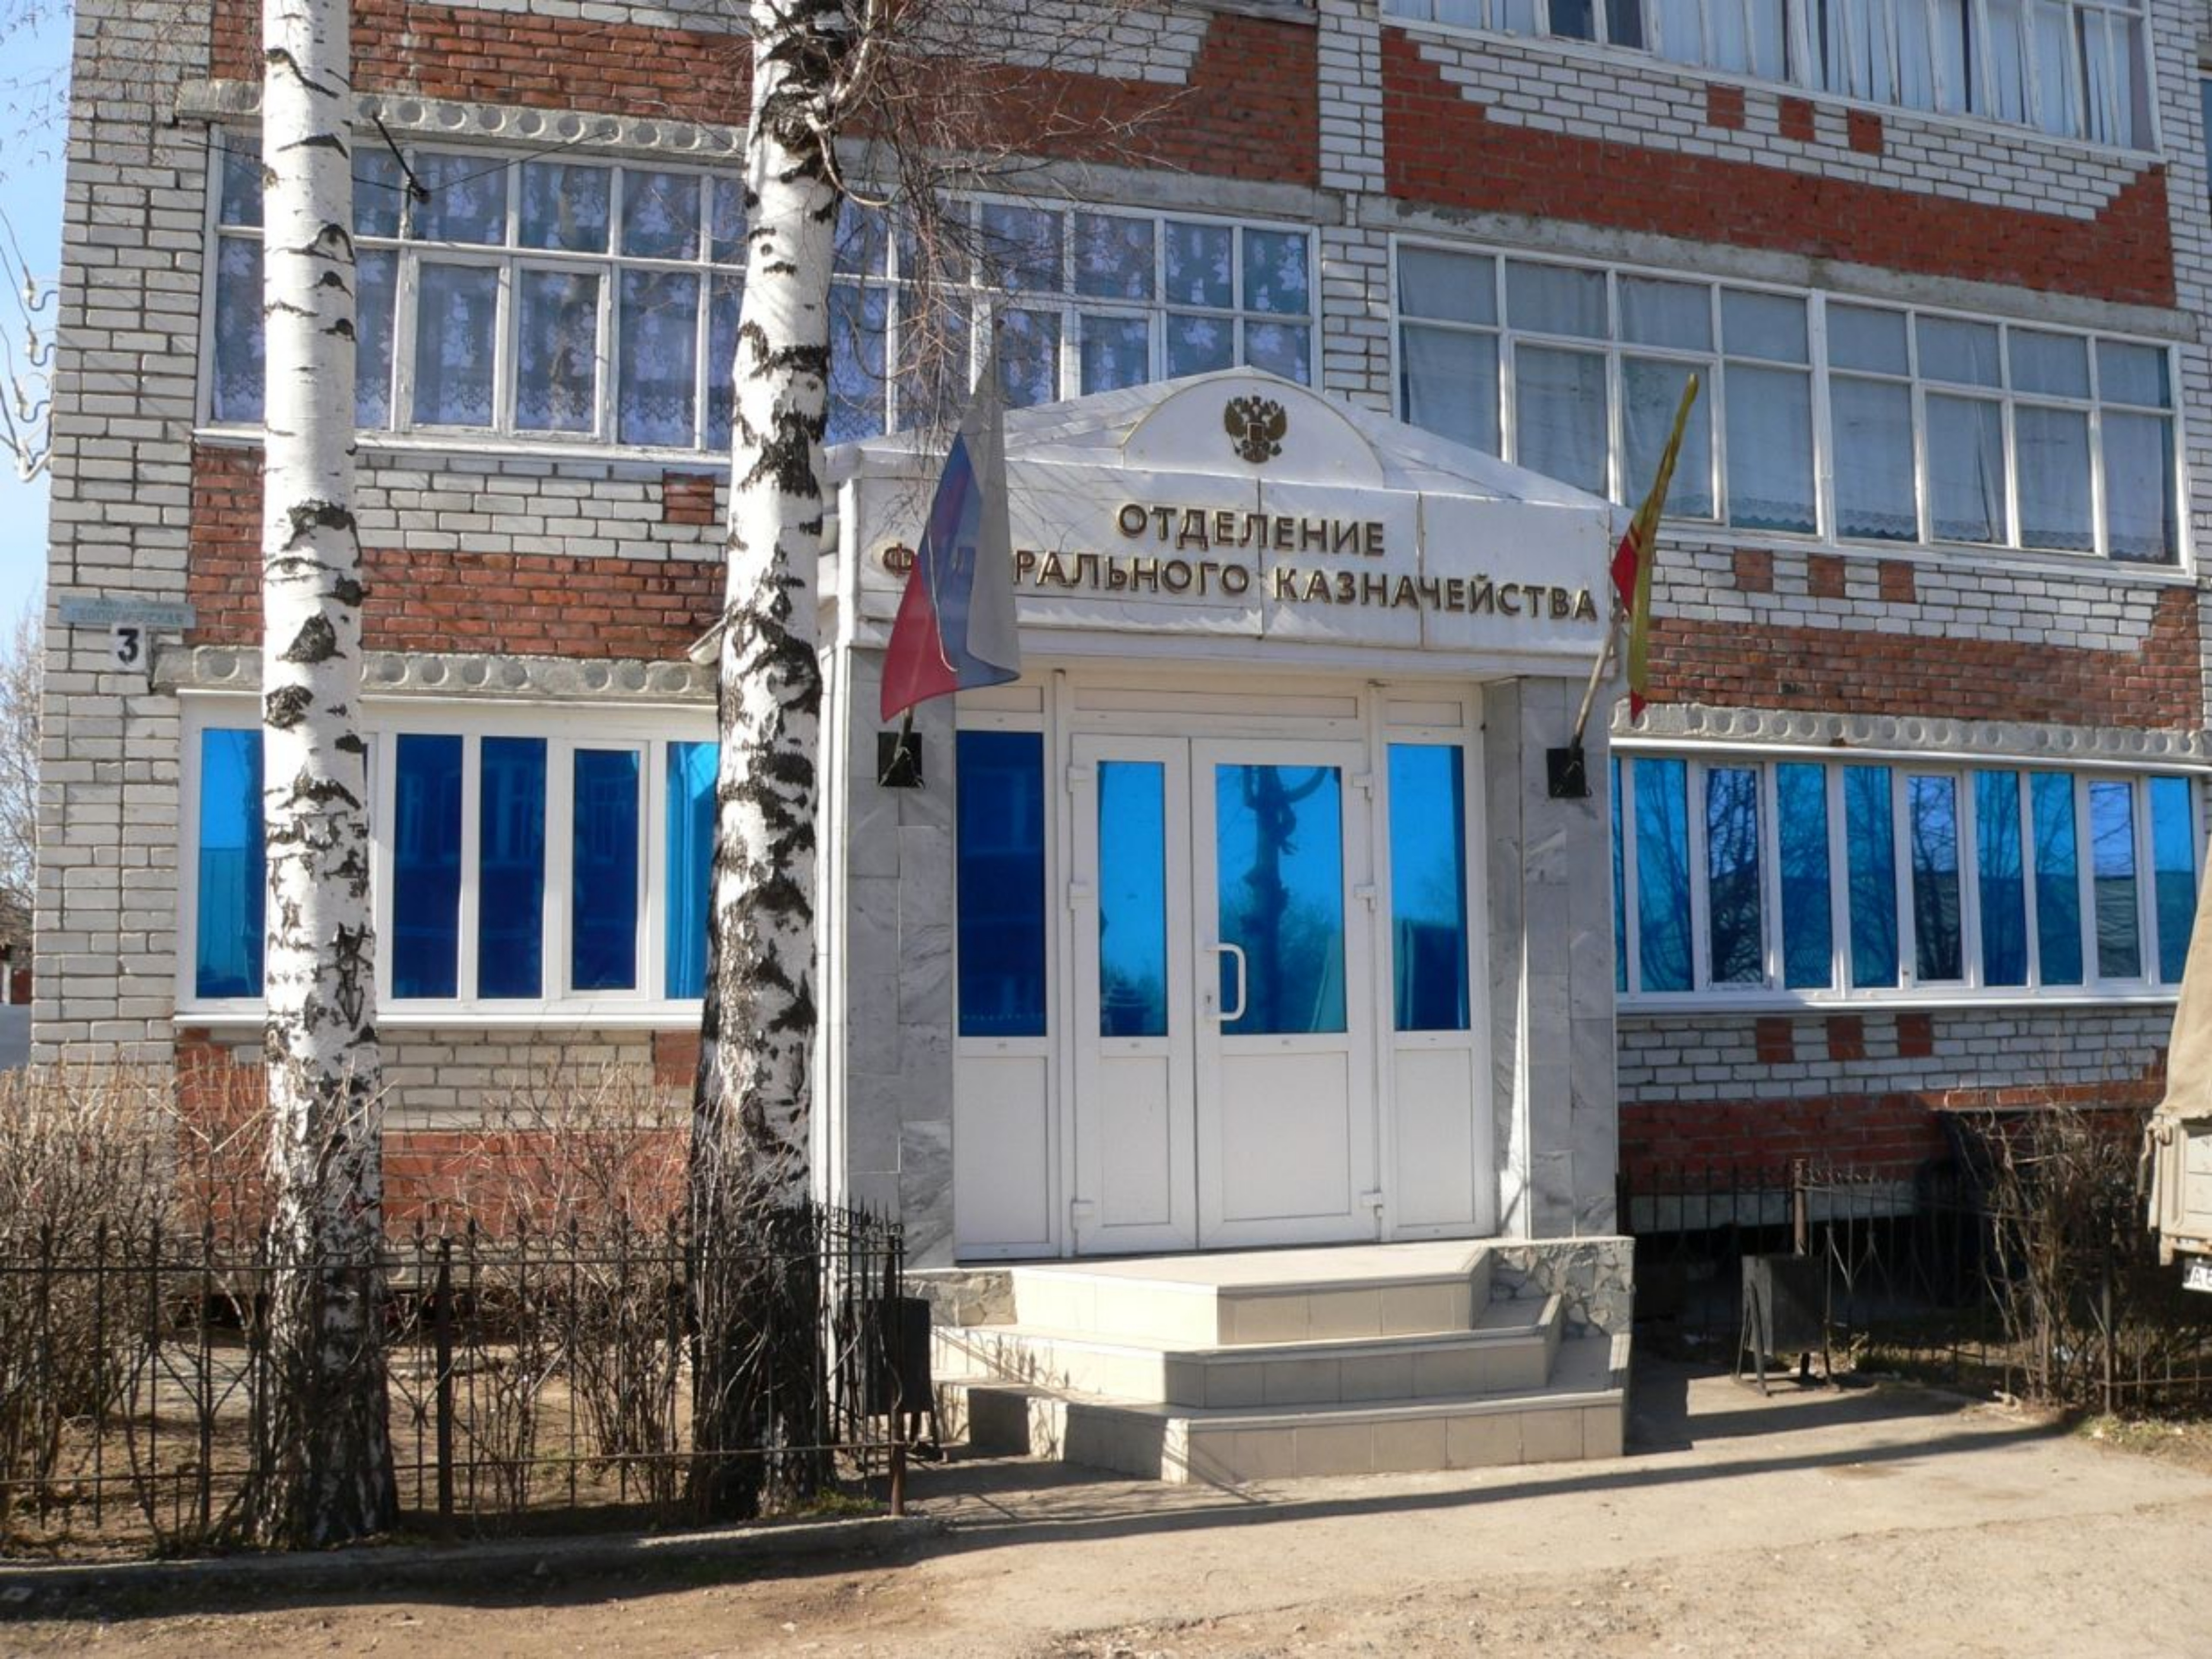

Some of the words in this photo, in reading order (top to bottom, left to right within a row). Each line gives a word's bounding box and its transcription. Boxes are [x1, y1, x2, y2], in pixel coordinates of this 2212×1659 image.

[1119, 503, 1385, 556] ОТДЕЛЕНИЕ
[882, 542, 1249, 595] ФРАЛЬНОГО
[1273, 566, 1598, 621] КАЗНАЧЕЙСТВА
[117, 628, 139, 666] 3
